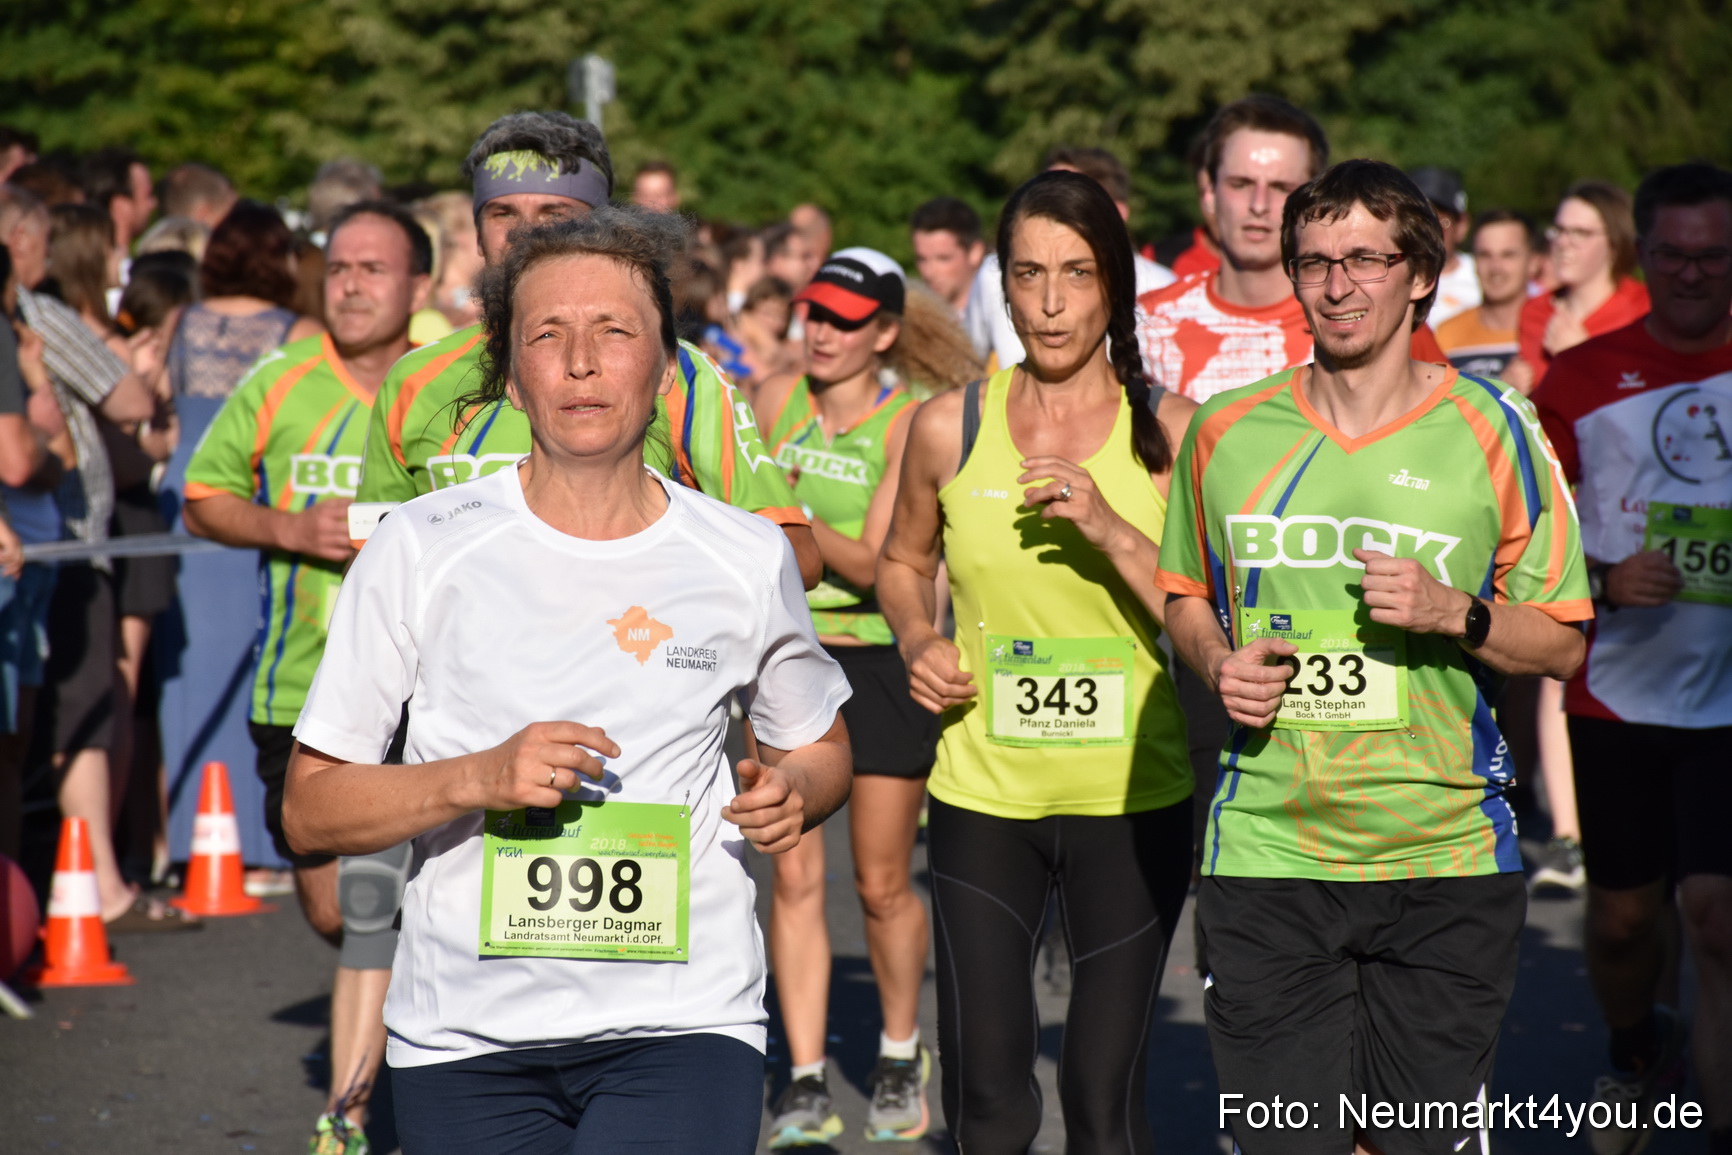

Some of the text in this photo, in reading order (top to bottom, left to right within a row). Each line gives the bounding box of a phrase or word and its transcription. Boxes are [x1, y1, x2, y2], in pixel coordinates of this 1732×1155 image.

[775, 441, 869, 487] BOCK
[291, 455, 361, 495] BO
[982, 489, 1009, 499] JAKO
[446, 500, 483, 521] JAKO
[1225, 514, 1462, 588] BOCK
[627, 628, 651, 641] NM
[1262, 628, 1313, 639] firmenlauf
[1320, 638, 1350, 649] 2018
[666, 646, 717, 660] LANDKREIS
[666, 658, 717, 672] NEUMARKT
[1058, 663, 1086, 673] 2018
[1276, 654, 1367, 696] 233
[1016, 677, 1098, 716] 343
[1282, 698, 1366, 711] Lang Stephan
[1295, 711, 1316, 719] Bock
[1325, 711, 1351, 719] GmbH
[1019, 718, 1096, 729] Pfanz Daniela
[511, 824, 583, 838] firmenlauf
[590, 837, 627, 851] 2018
[527, 856, 643, 914] 998
[508, 914, 662, 934] Lansberger Dagmar
[504, 931, 664, 945] Landratsamt Neumarkt i.d.OPf.
